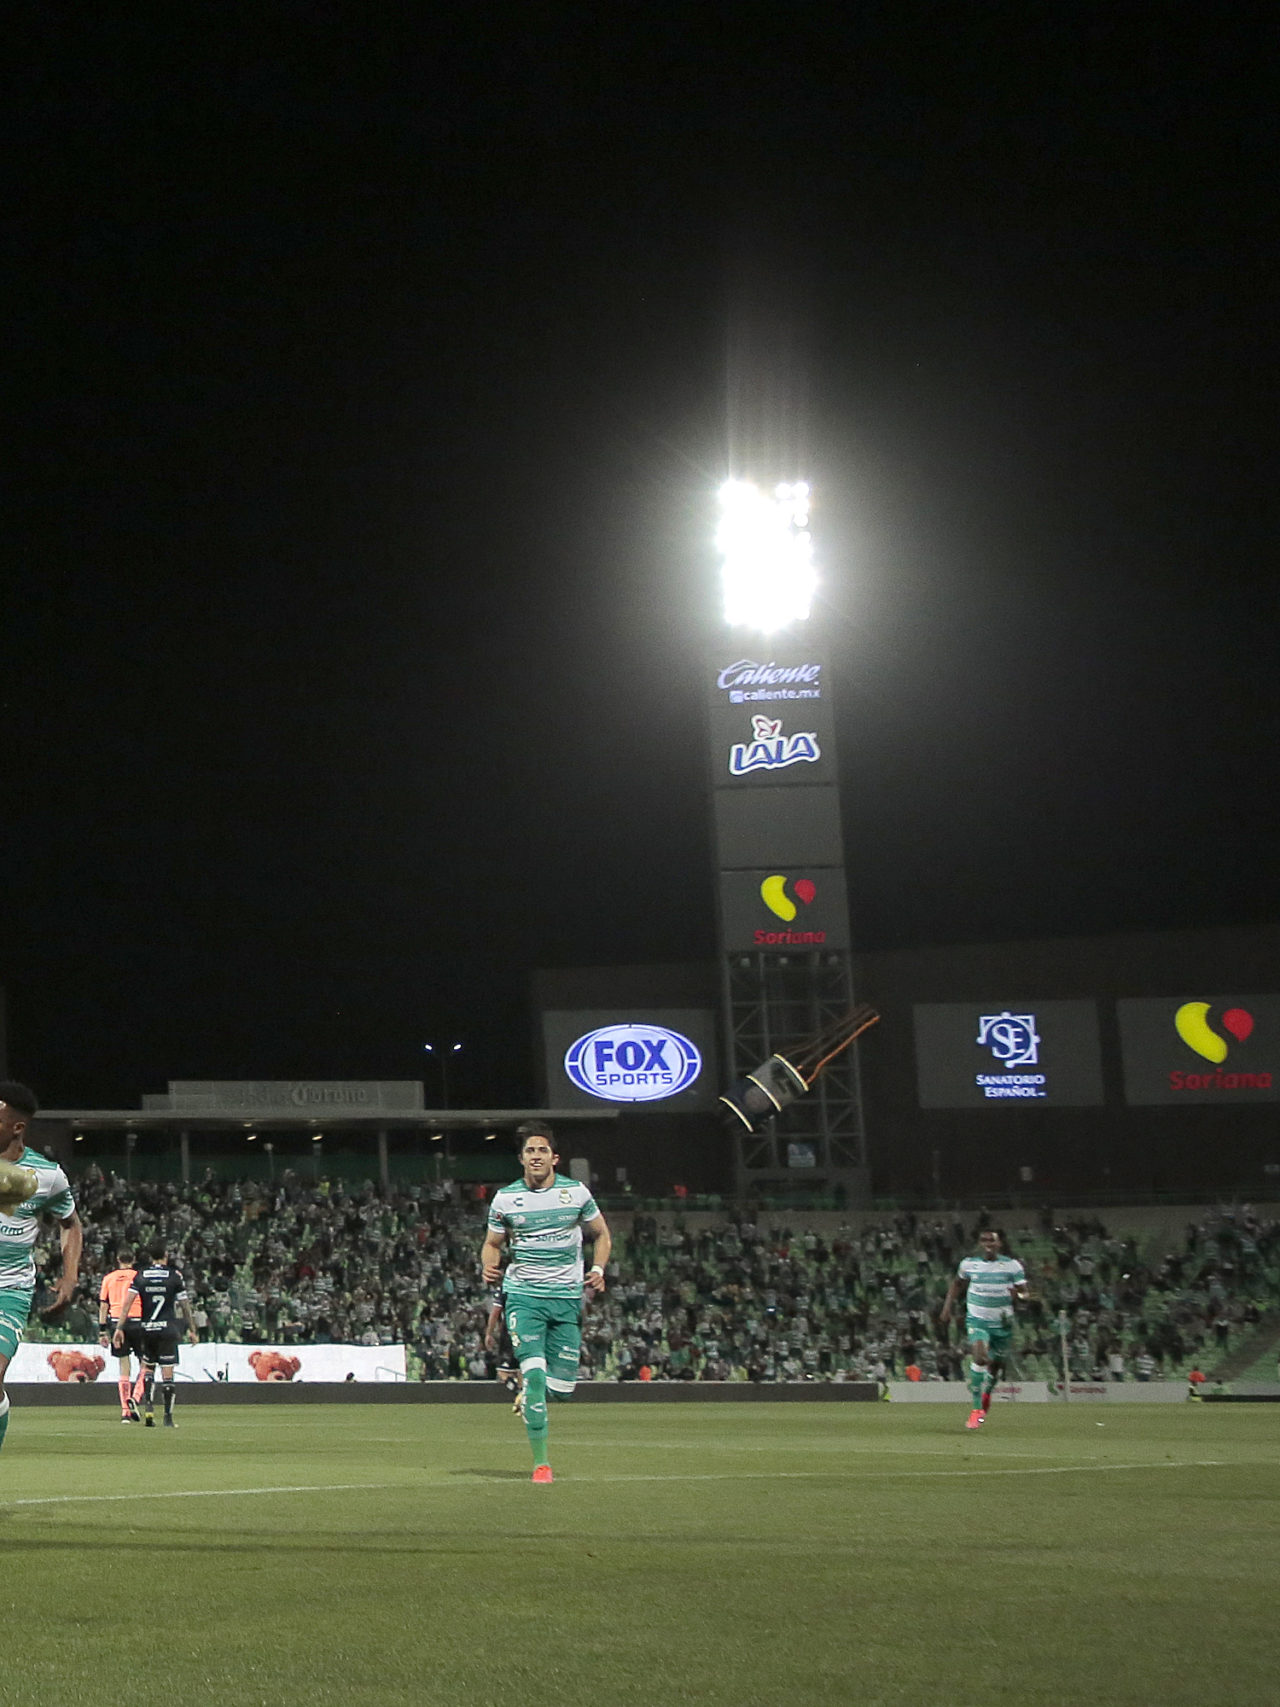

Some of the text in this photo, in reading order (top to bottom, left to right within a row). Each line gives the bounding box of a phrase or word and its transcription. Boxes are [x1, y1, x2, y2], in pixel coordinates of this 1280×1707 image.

[717, 660, 820, 688] Caliente
[730, 733, 820, 775] LALA
[753, 928, 826, 944] Soriana
[594, 1040, 670, 1072] FOX
[596, 1073, 673, 1085] SPORTS
[976, 1074, 1046, 1085] SANATORIO
[1169, 1068, 1272, 1090] Soriana
[151, 1294, 165, 1320] 7
[509, 1312, 517, 1329] 6
